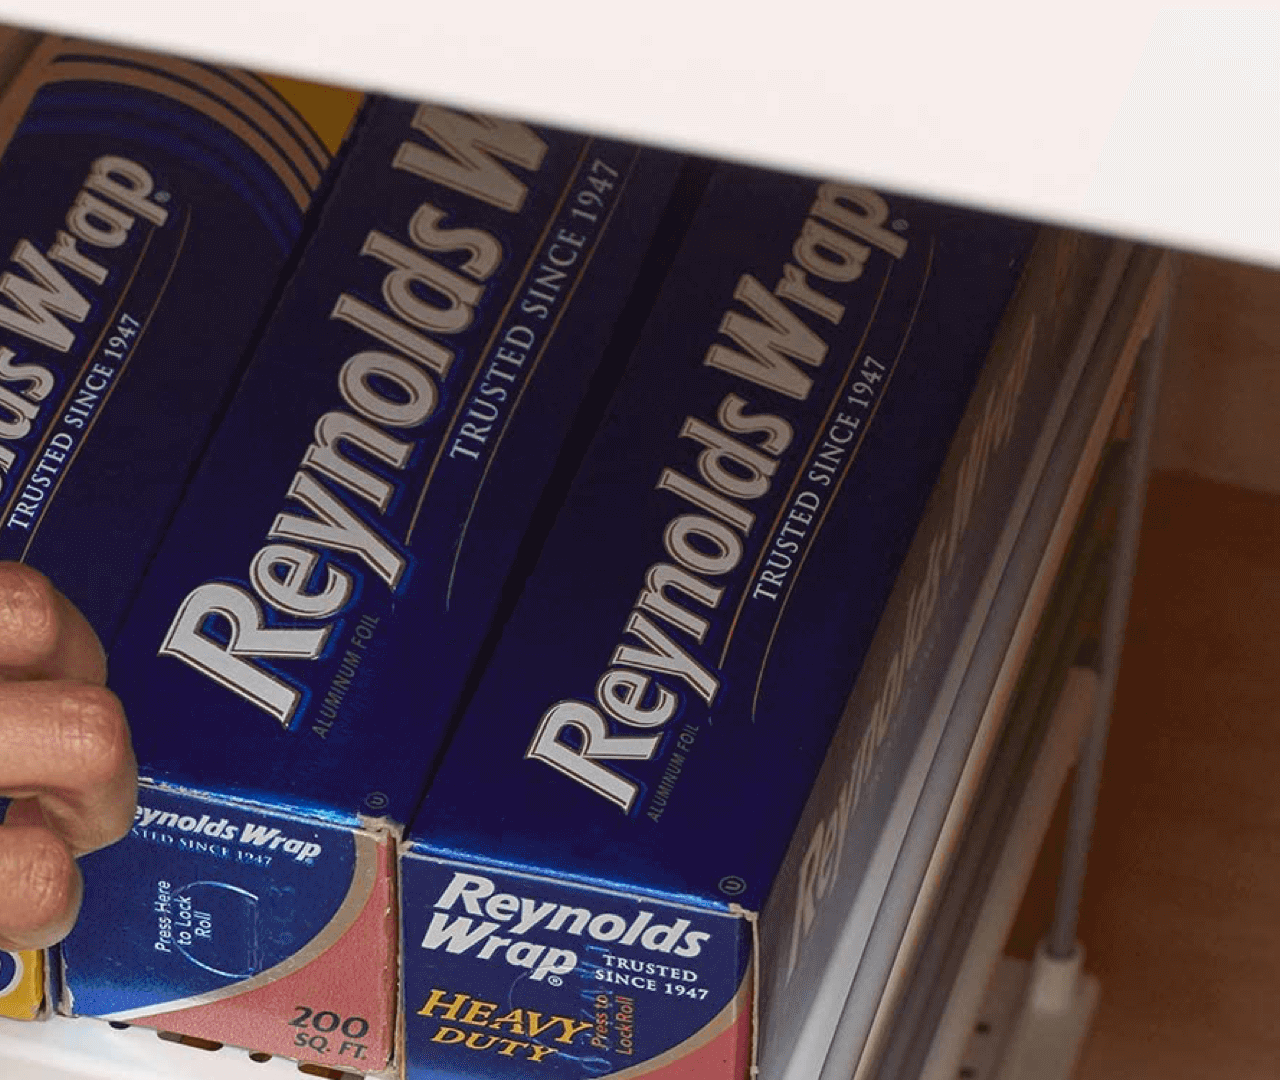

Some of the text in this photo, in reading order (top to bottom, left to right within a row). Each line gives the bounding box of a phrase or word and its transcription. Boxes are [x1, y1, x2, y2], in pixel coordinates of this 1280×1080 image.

[448, 158, 621, 463] TRUSTED SINCE 1947
[6, 313, 143, 531] TRUSTED SINCE 1947
[157, 202, 502, 731] Reynolds
[753, 355, 889, 604] TRUSTED SINCE 1947
[526, 180, 908, 813] Reynolds Wrap
[310, 613, 382, 740] ALUMINUM FOIL
[646, 722, 700, 824] ALUMINUM FOIL
[135, 804, 322, 861] eynolds Wrap
[179, 836, 273, 865] SINCE 1947
[154, 880, 172, 953] Press Here
[175, 895, 192, 947] to Lock
[194, 911, 211, 939] Roll
[433, 871, 710, 958] Reynolds
[421, 912, 578, 981] Wrap
[601, 953, 699, 984] TRUSTED
[594, 969, 709, 1001] SINCE 1947
[288, 1005, 370, 1039] 200
[293, 1032, 368, 1061] SQ. FT.
[416, 989, 595, 1046] HEAVY
[430, 1025, 559, 1063] DUTY
[591, 994, 609, 1051] Press to
[615, 995, 636, 1057] Lock Roll
